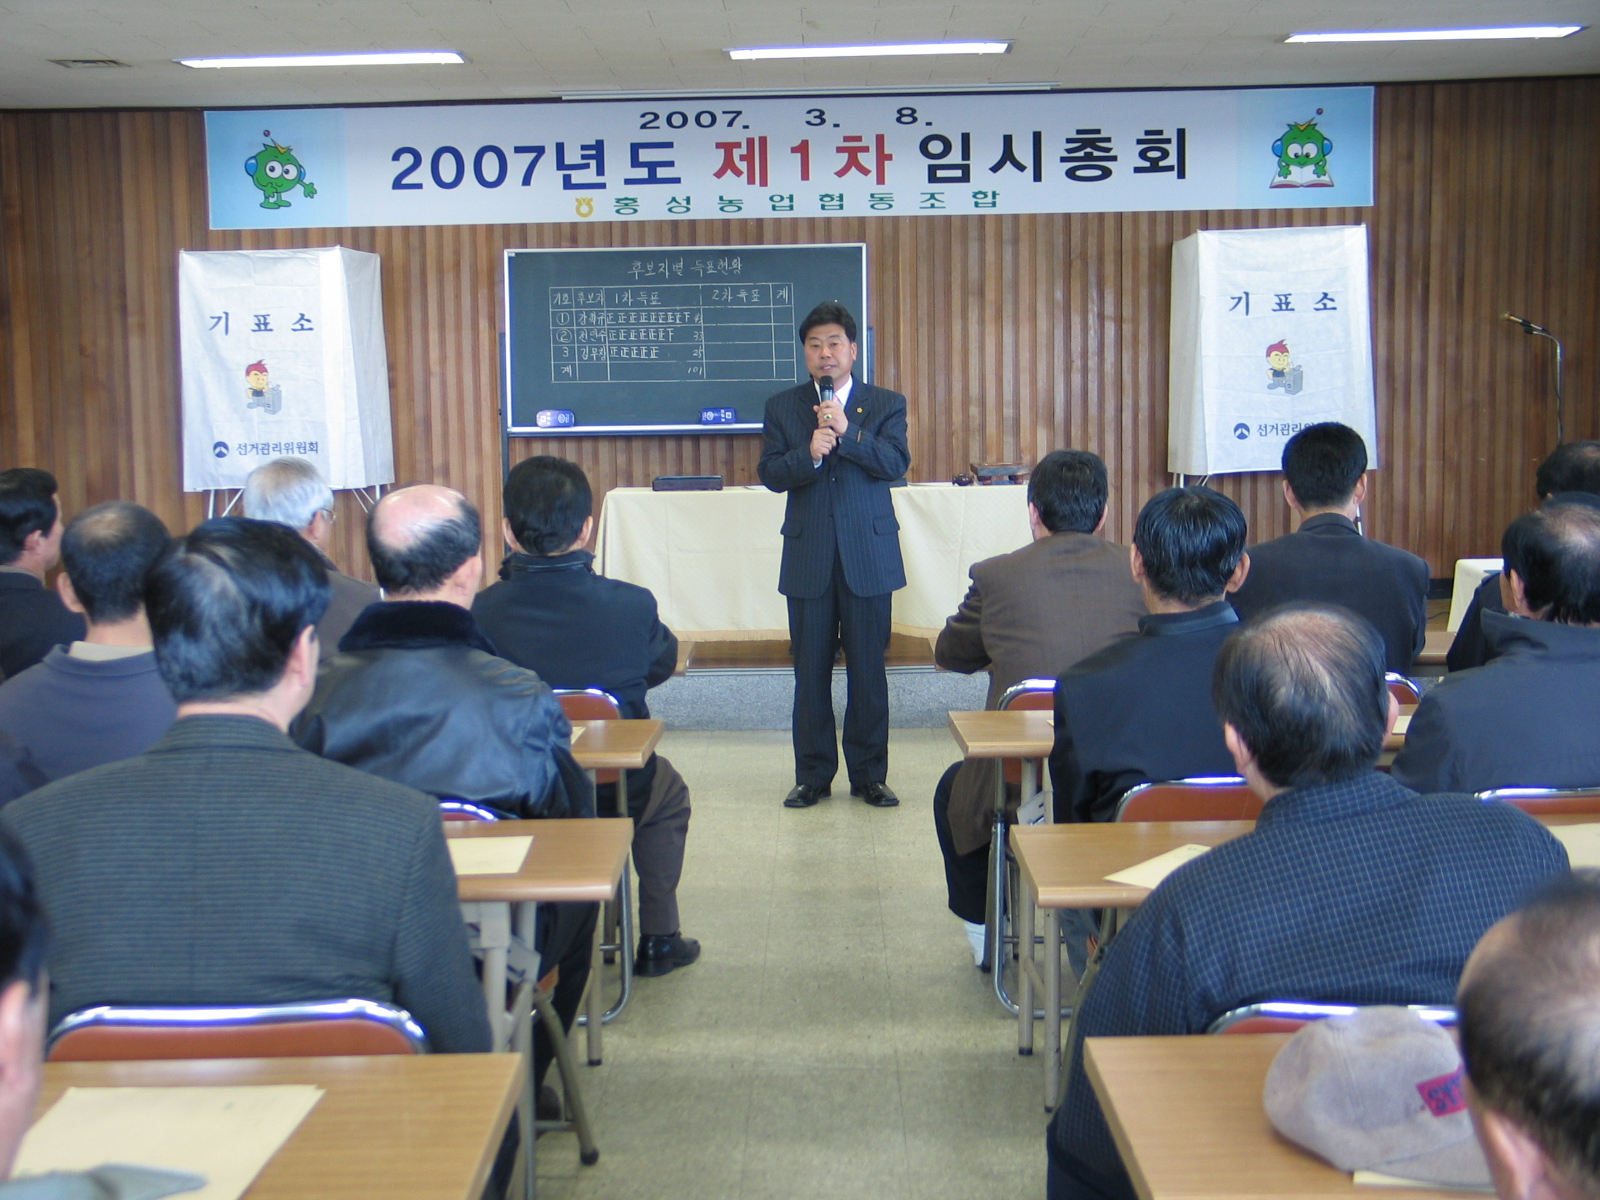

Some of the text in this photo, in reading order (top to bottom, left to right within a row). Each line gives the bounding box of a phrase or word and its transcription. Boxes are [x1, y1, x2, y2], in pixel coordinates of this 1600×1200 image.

[638, 106, 933, 130] 2007. 3. 8.
[391, 128, 1187, 191] 2007년도 제1차 임시총회
[1228, 291, 1338, 317] 기표소
[208, 311, 314, 336] 기표소
[236, 441, 319, 456] 선거관리위원회
